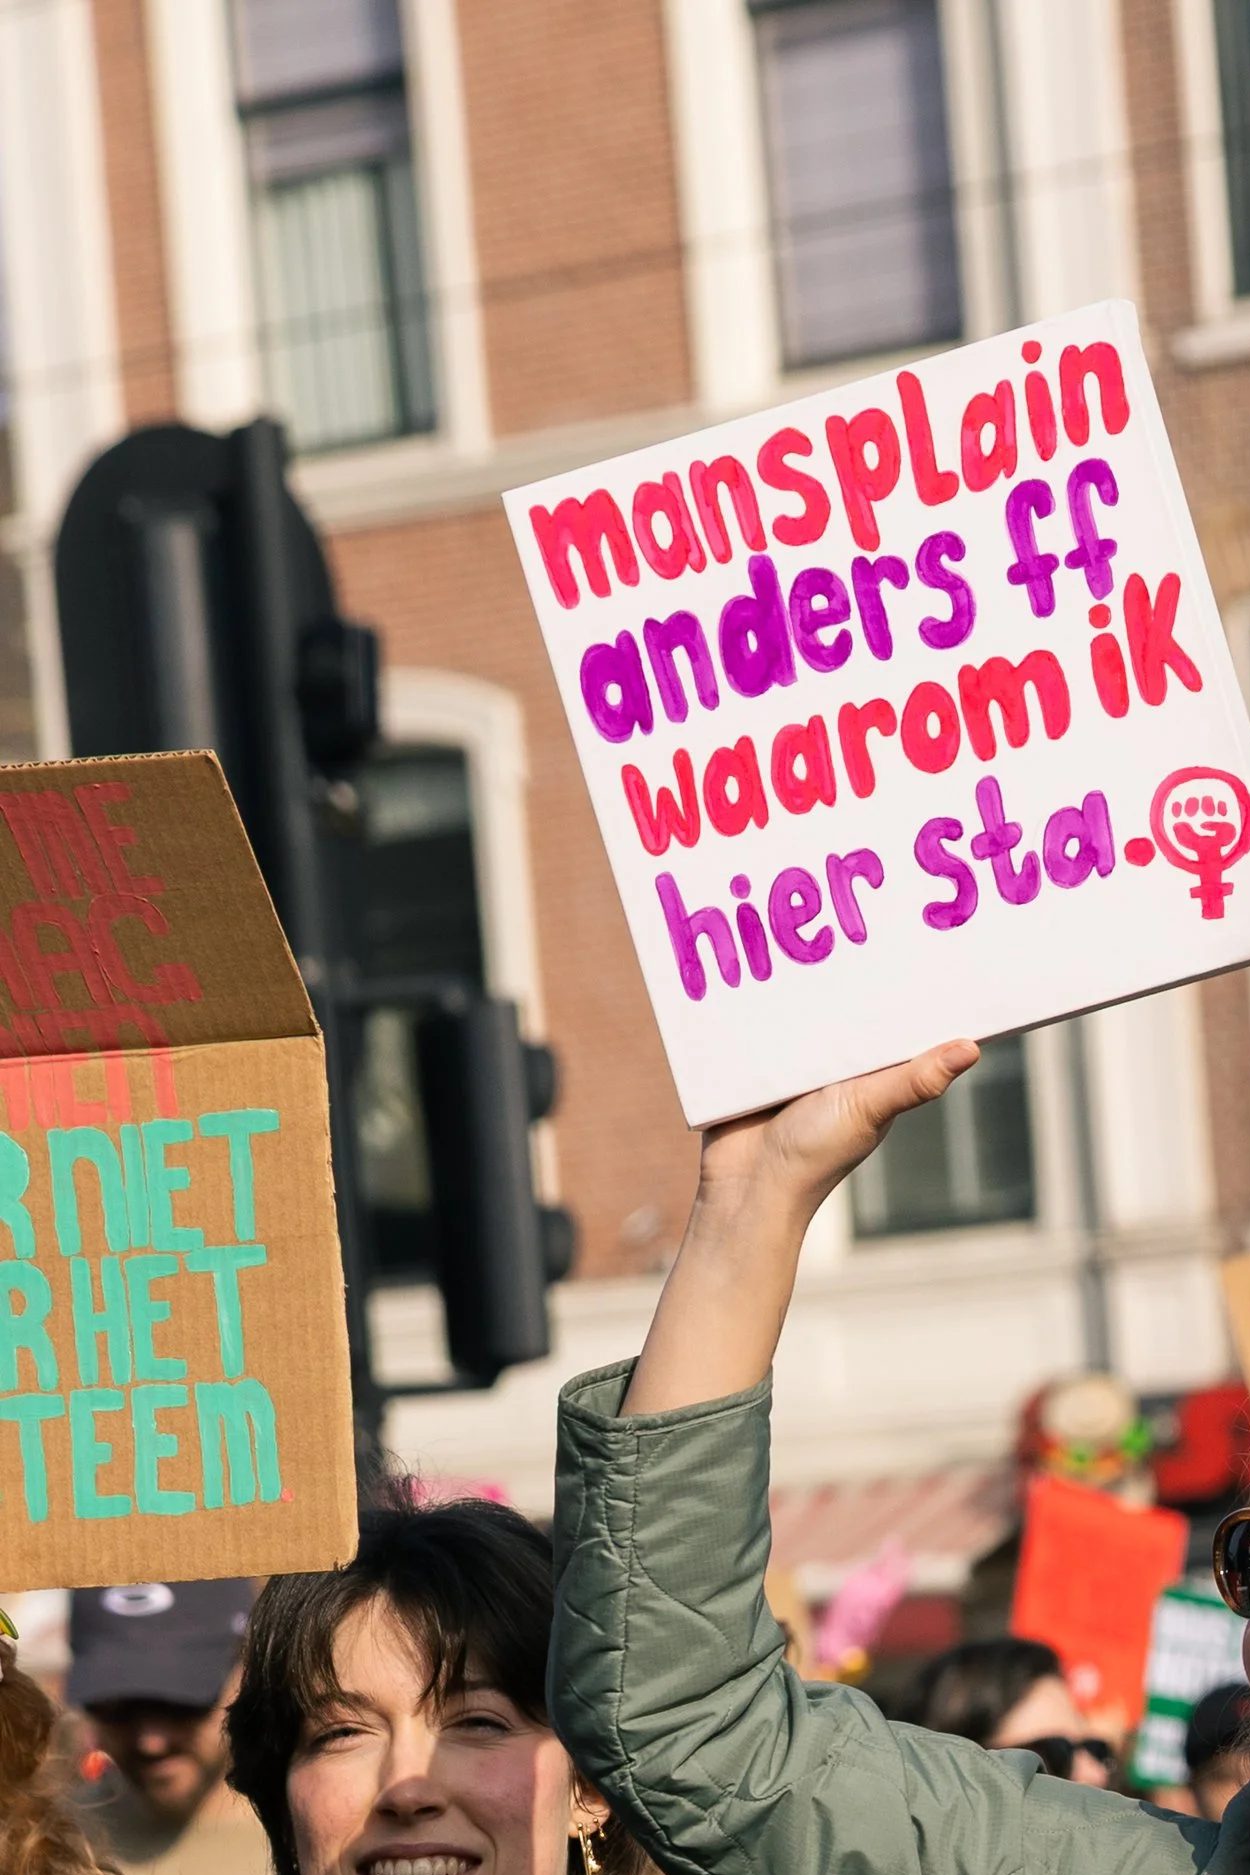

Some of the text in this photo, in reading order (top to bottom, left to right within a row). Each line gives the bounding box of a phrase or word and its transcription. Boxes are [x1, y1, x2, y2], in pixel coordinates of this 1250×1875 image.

[529, 340, 1131, 610] mansplain
[579, 458, 1120, 744] anders ff
[621, 650, 1071, 857] waarom
[655, 775, 1156, 1002] hier sta.
[47, 1108, 280, 1259] NIET
[70, 1244, 268, 1387] HET
